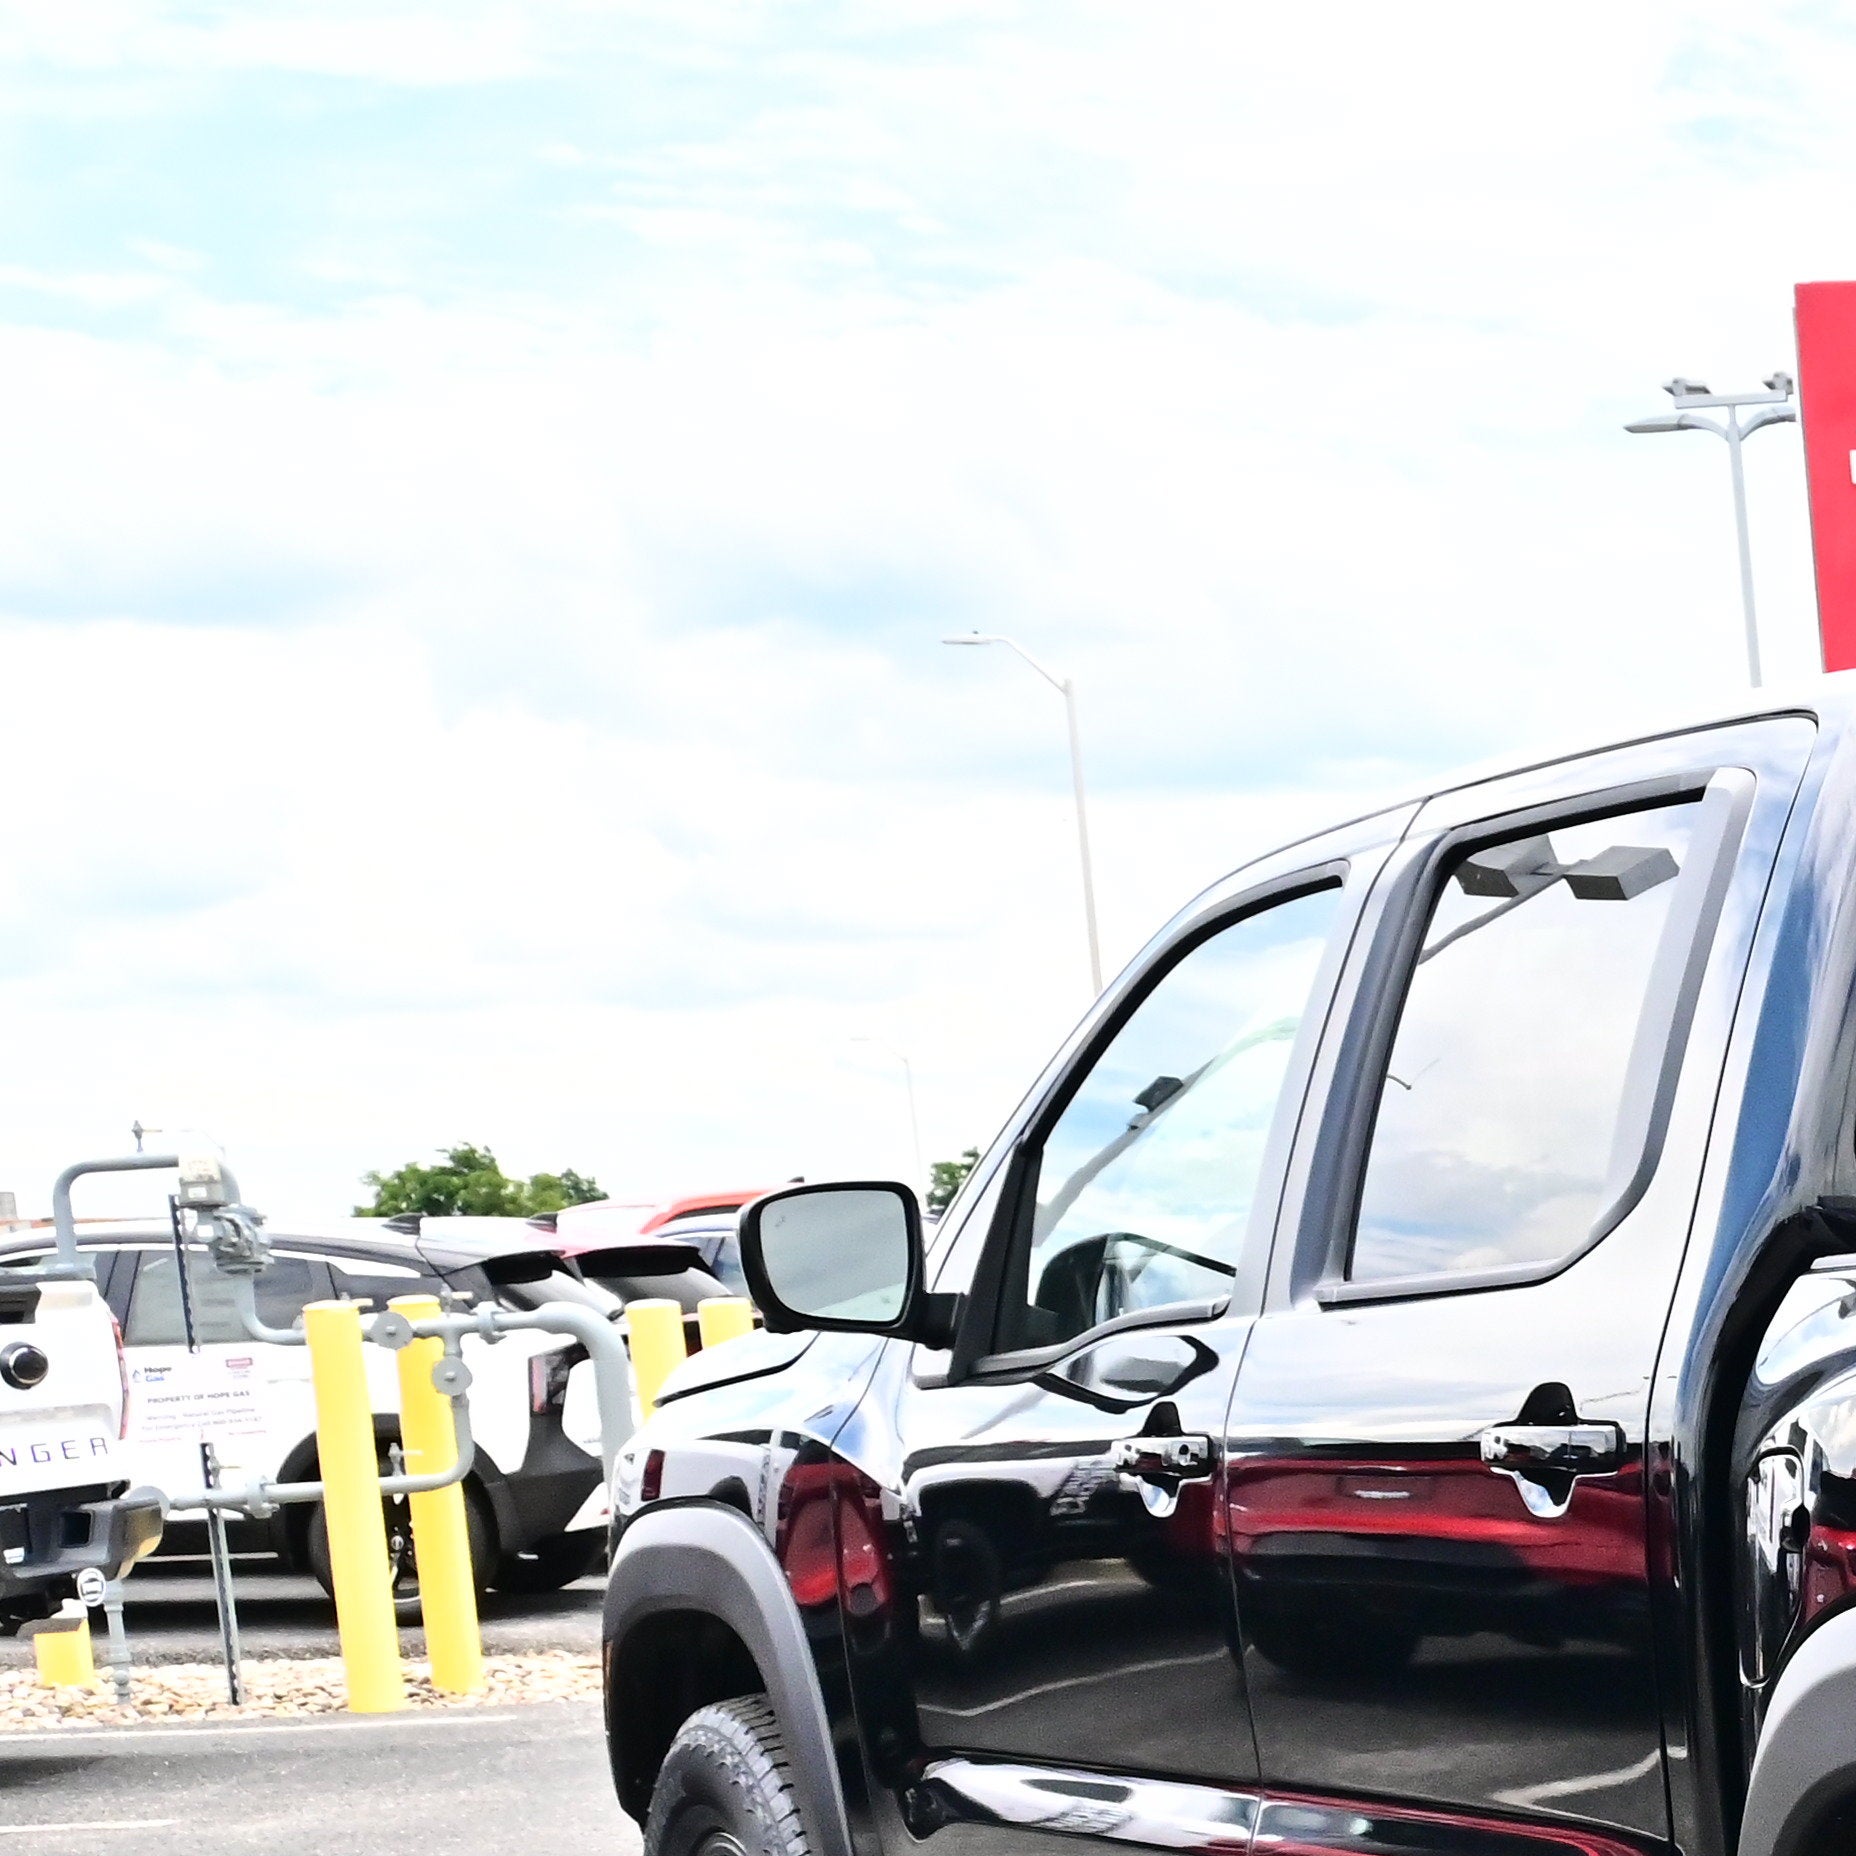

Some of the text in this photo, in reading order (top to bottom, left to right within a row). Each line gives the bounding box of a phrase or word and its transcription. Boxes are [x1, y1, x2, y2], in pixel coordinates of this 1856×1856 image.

[144, 1366, 172, 1375] Hope
[147, 1389, 251, 1404] PROPERTY OF HOPE GAS
